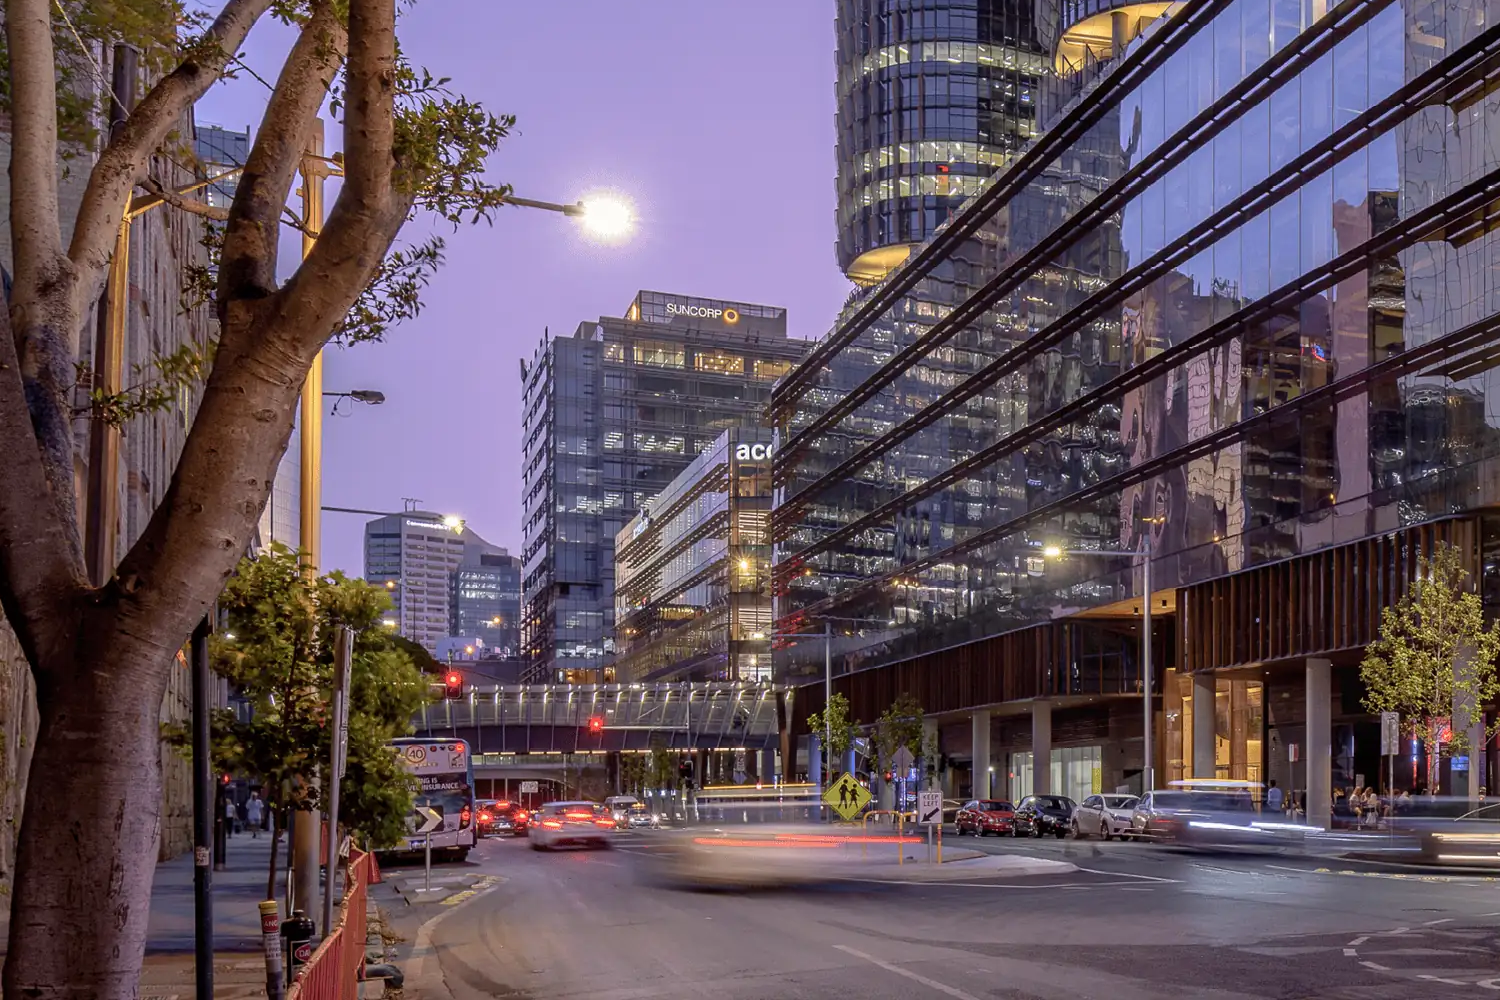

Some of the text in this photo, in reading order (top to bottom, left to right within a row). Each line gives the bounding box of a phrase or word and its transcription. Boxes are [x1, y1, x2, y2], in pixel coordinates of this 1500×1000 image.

[666, 303, 722, 319] SUNCORP
[409, 749, 424, 759] 40
[421, 782, 459, 791] INSURANCE
